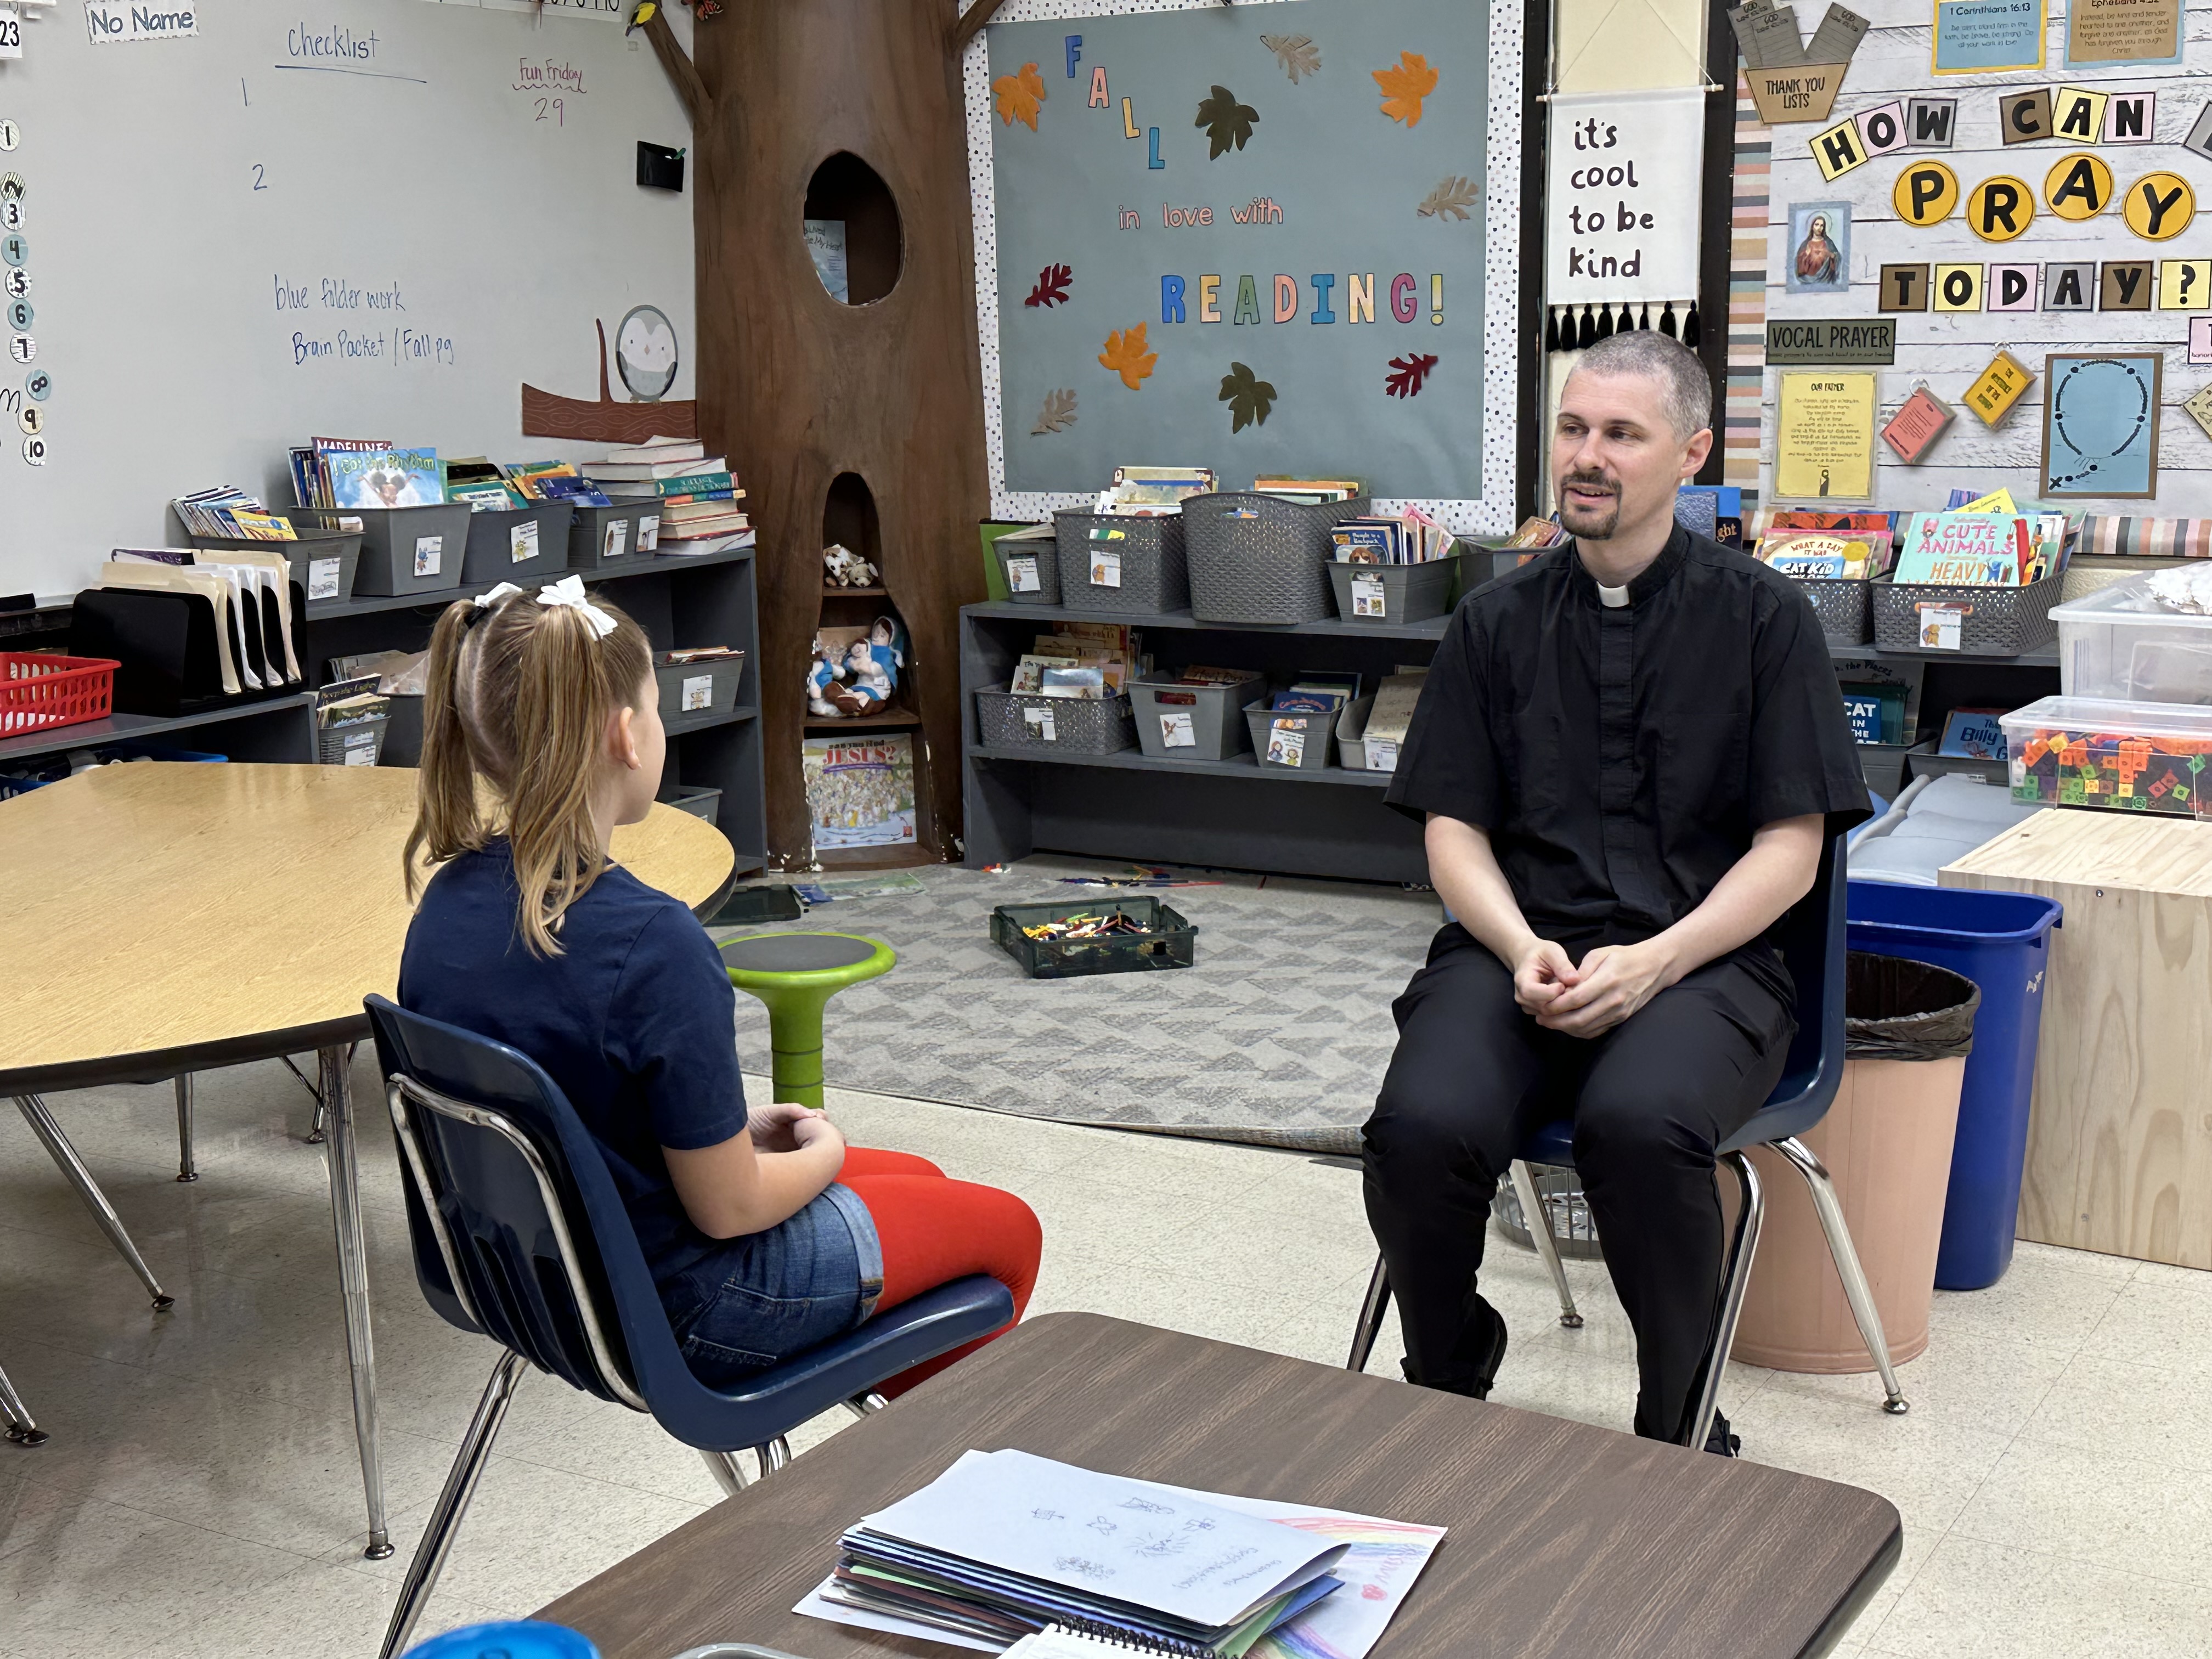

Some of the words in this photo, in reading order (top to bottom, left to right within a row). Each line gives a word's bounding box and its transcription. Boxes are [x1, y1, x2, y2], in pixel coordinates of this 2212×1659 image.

[91, 10, 123, 35] No
[132, 5, 195, 31] Name
[288, 22, 380, 59] Checklist
[519, 57, 543, 82] Fun
[545, 59, 583, 89] Friday
[1765, 78, 1801, 95] THANK
[1805, 76, 1826, 93] YOU
[534, 97, 565, 127] 29
[1065, 35, 1166, 170] FALL
[1783, 94, 1810, 109] LISTS
[4, 126, 10, 147] 1
[1821, 105, 1951, 173] HOW
[2012, 97, 2144, 137] CAN
[251, 163, 268, 191] 2
[1571, 160, 1639, 189] cool
[1909, 159, 2183, 235] PRAY
[8, 204, 19, 223] 3
[1118, 205, 1141, 230] in
[1163, 202, 1214, 228] love
[1231, 197, 1284, 225] with
[1568, 205, 1605, 235] to
[1617, 200, 1655, 233] be
[8, 239, 20, 259] 4
[1568, 246, 1641, 279] kind
[13, 273, 26, 295] 5
[274, 274, 309, 311] blue
[321, 278, 360, 309] folder
[366, 280, 406, 312] work
[1894, 264, 2197, 307] TODAY?
[1161, 273, 1444, 326] READING!
[15, 305, 27, 324] 6
[292, 331, 333, 365] Brain
[337, 329, 385, 358] Packet
[403, 329, 432, 358] Fall
[437, 335, 454, 365] pg
[1773, 326, 1824, 348] VOCAL
[1830, 325, 1889, 348] PRAYER
[18, 340, 30, 360] 7
[31, 375, 48, 393] 8
[24, 409, 37, 431] 9
[29, 440, 44, 459] 10
[1942, 524, 1999, 540] CUTE
[1791, 541, 1815, 552] WHAT
[1915, 539, 2015, 555] ANIMALS
[1779, 562, 1807, 574] CAT
[1929, 561, 1988, 581] HEAVY
[1843, 702, 1876, 718] CAT
[1852, 719, 1866, 728] IN
[1960, 726, 1999, 746] Billy
[822, 745, 896, 766] JESUS?
